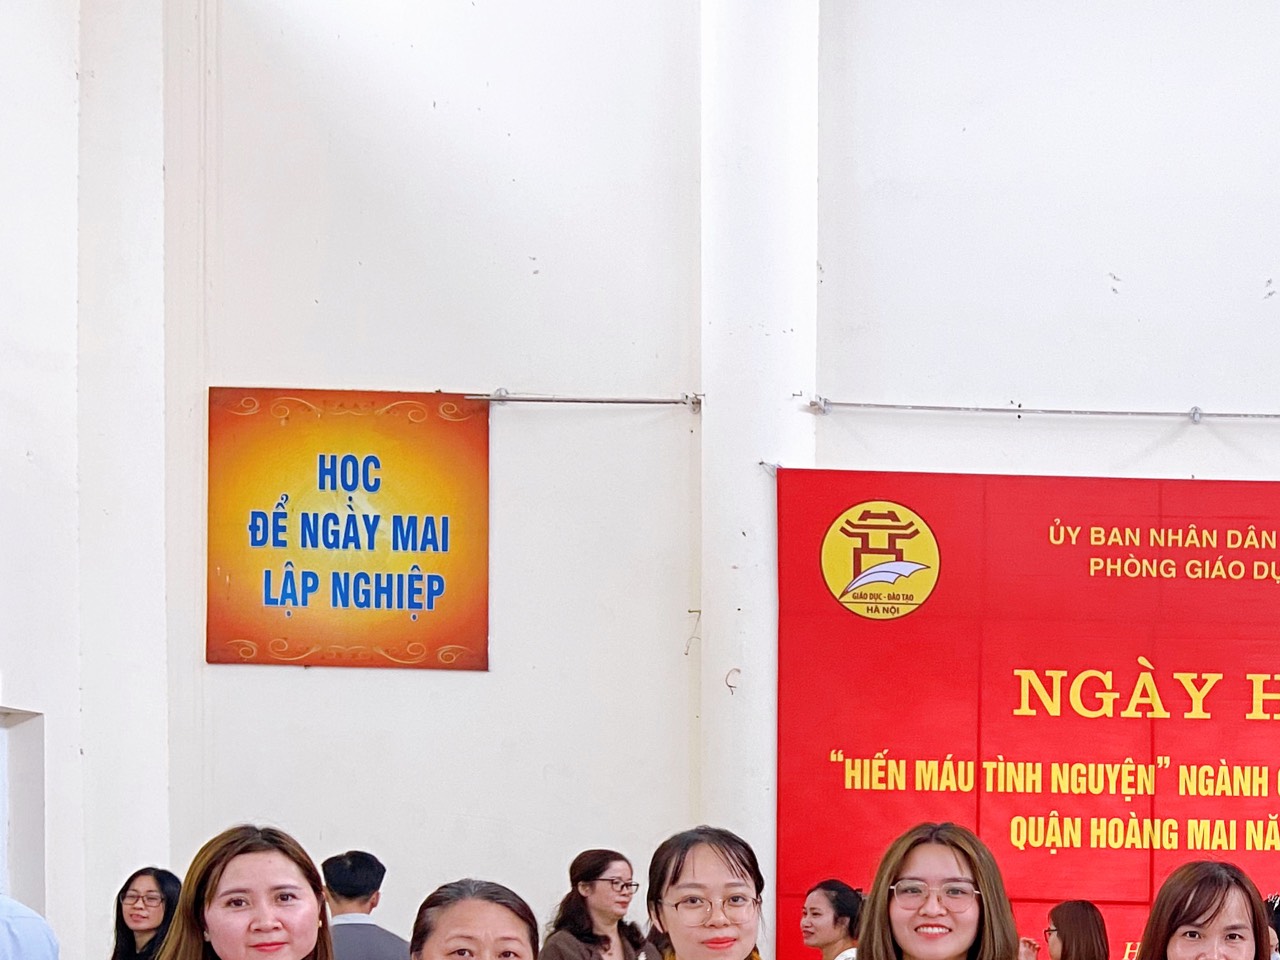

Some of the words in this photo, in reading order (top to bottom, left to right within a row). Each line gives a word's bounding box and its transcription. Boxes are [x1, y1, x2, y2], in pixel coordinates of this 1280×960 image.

[317, 453, 382, 503] HỌC
[248, 493, 289, 548] ĐỂ
[300, 503, 381, 552] NGÀY
[391, 514, 449, 553] MAI
[1049, 518, 1081, 545] ỦY
[1090, 526, 1141, 547] BAN
[1149, 523, 1217, 548] NHÂN
[1226, 524, 1277, 549] DÂN
[1089, 553, 1177, 579] PHÒNG
[1185, 555, 1246, 580] GIÁO
[262, 560, 320, 618] LẬP
[330, 564, 446, 622] NGHIỆP
[852, 591, 868, 601] GIÁO
[887, 591, 901, 601] ĐÀO
[866, 605, 880, 614] HÀ
[882, 606, 900, 616] NỘI
[1012, 655, 1224, 719] NGÀY
[915, 753, 975, 793] MÁU
[982, 755, 1043, 794] TÌNH
[1178, 759, 1269, 798] NGÀNH
[1009, 810, 1082, 855] QUẬN
[1089, 812, 1179, 850] HOÀNG
[1187, 818, 1237, 851] MAI
